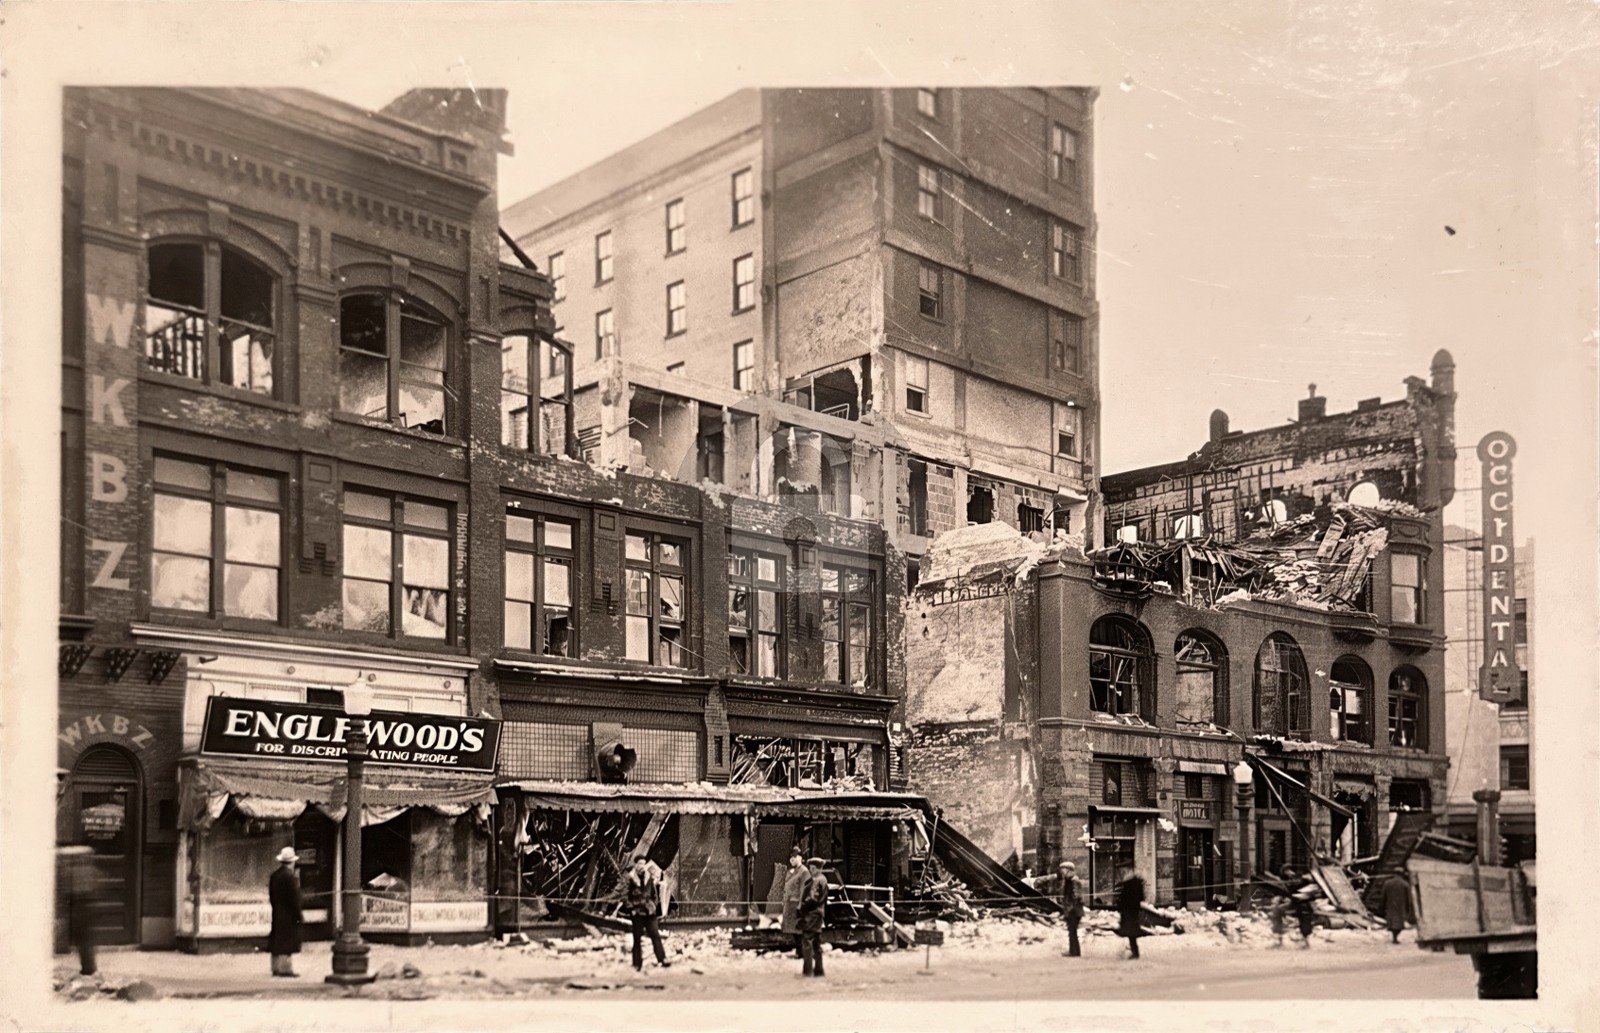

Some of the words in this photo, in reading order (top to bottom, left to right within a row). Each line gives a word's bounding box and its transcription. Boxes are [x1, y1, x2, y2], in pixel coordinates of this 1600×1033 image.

[86, 293, 137, 591] WKBZ
[57, 713, 154, 750] WKBZ
[223, 708, 486, 752] ENGLEWOOD'S
[255, 742, 285, 754] FOR
[290, 744, 410, 761] DISCRIATING
[412, 752, 459, 765] PEOPLE
